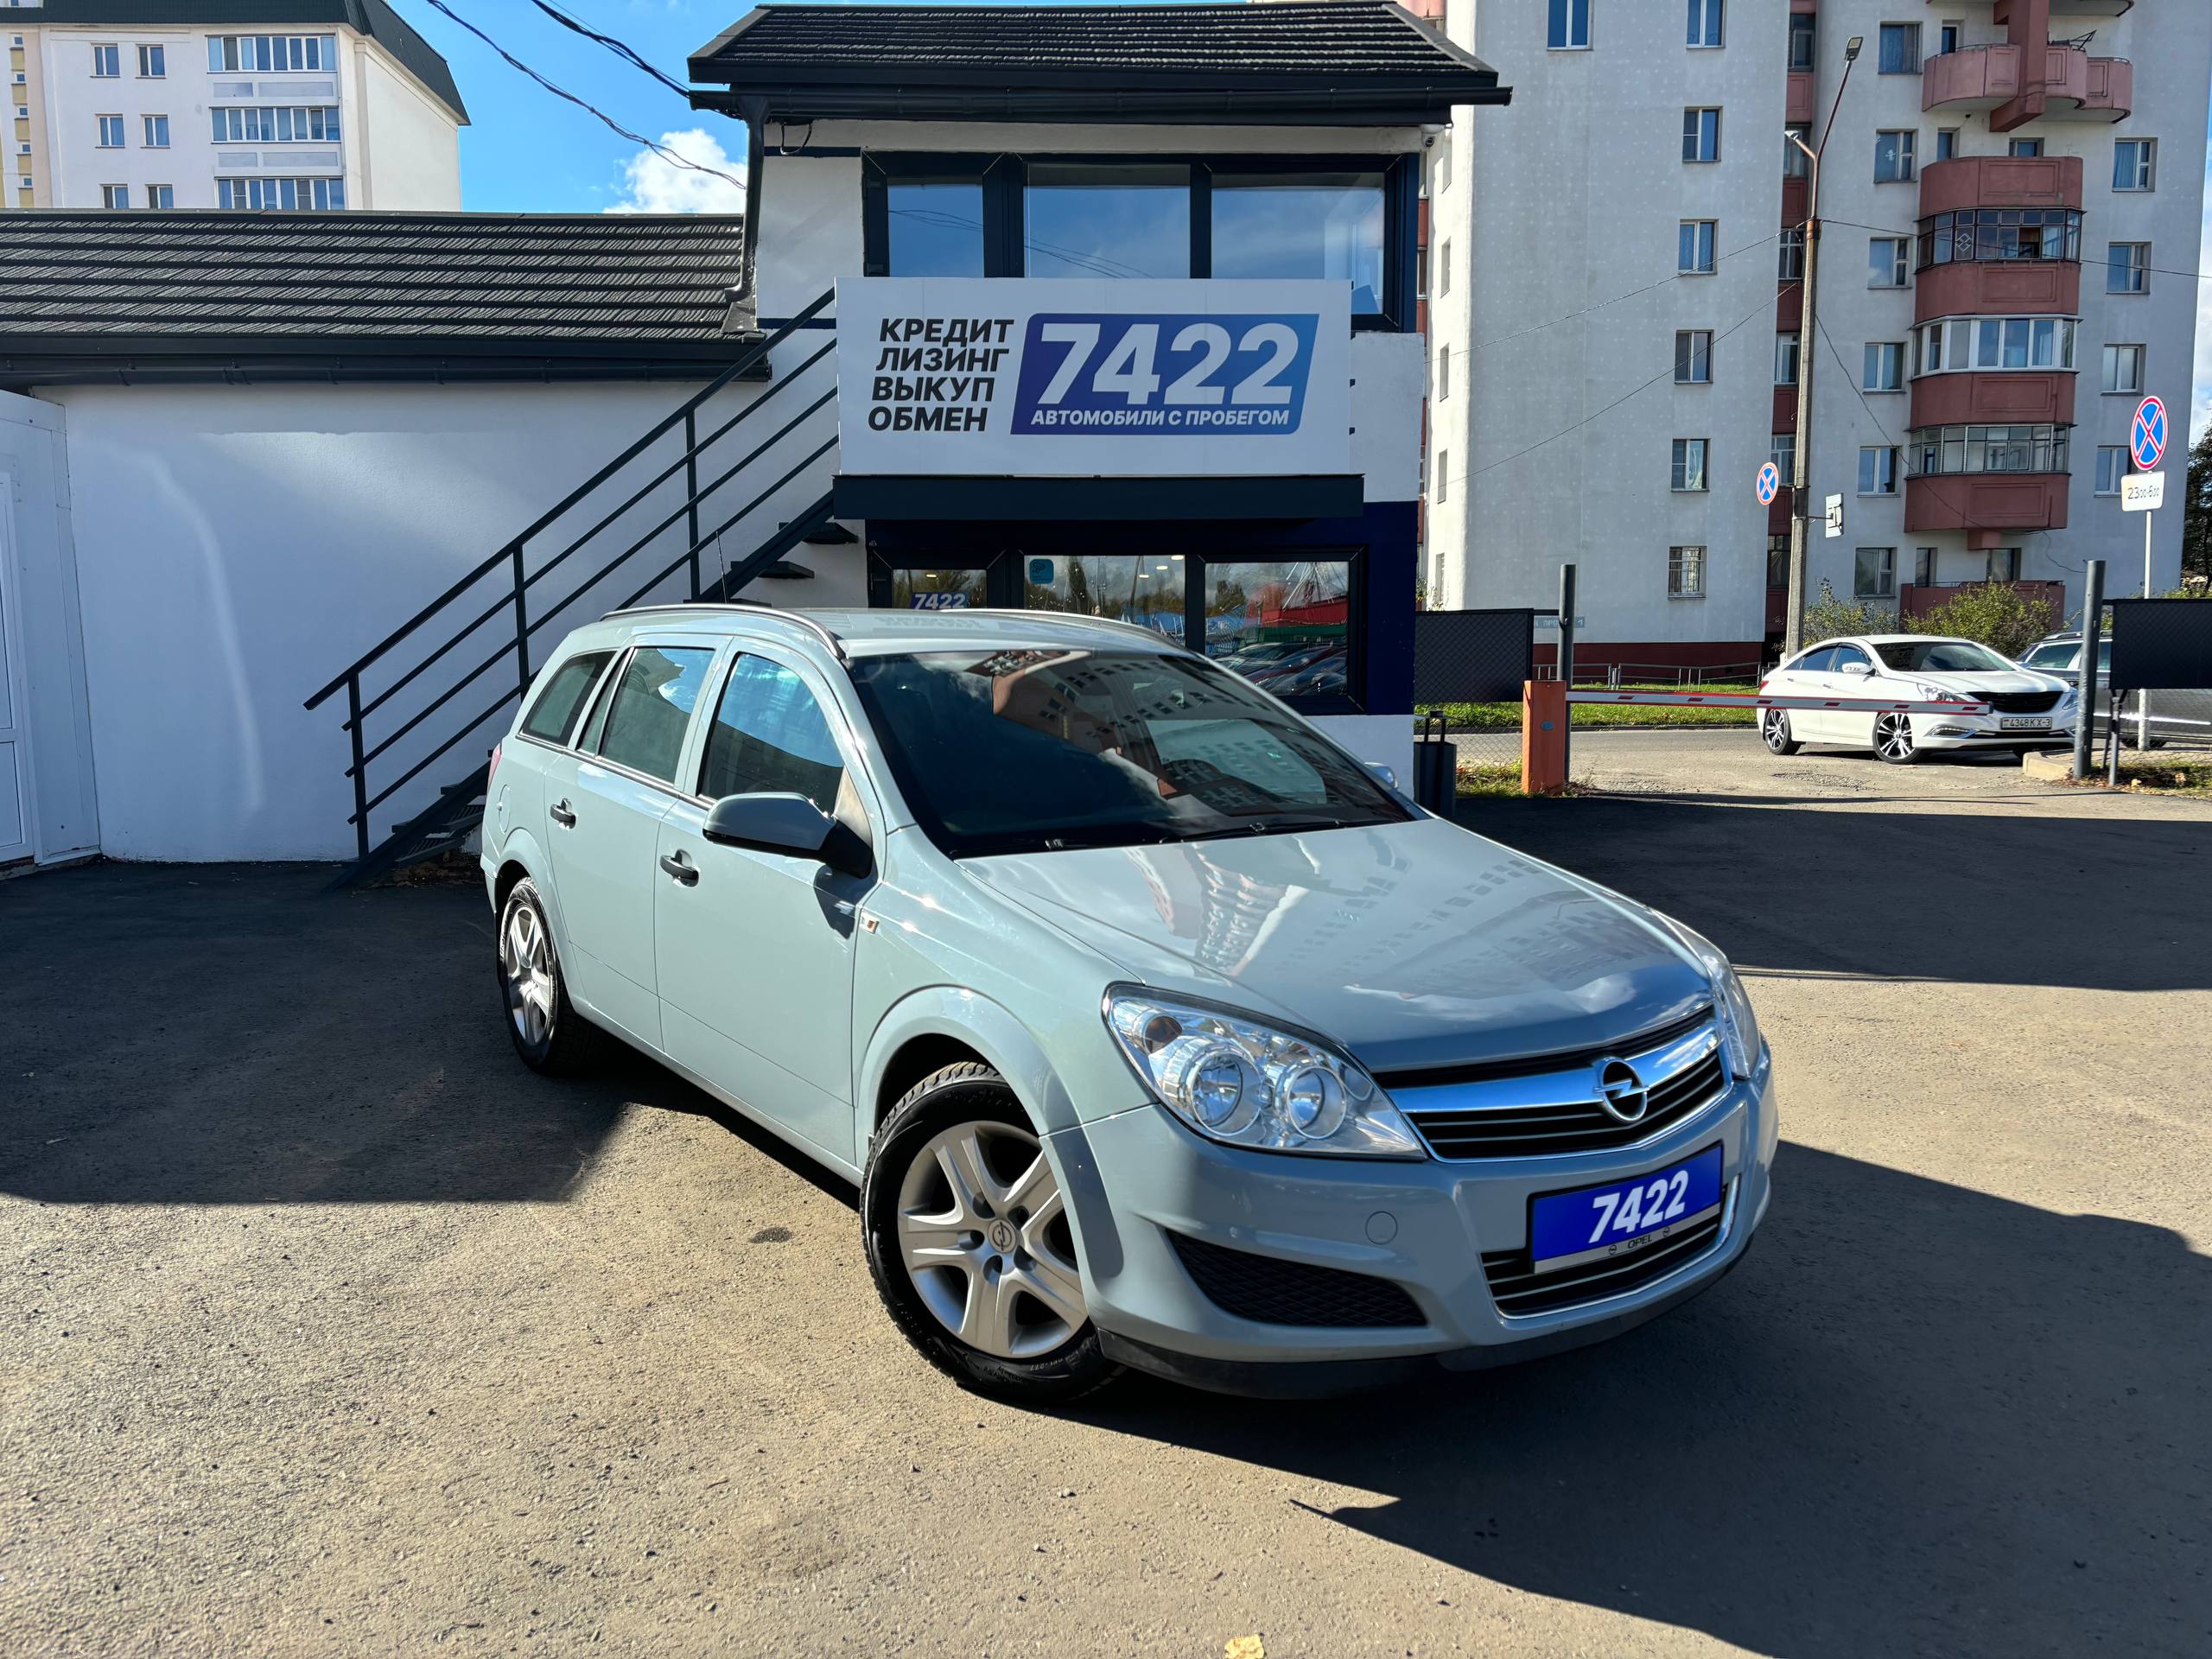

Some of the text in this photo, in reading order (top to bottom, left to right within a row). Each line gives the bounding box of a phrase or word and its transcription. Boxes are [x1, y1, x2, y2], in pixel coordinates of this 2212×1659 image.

[879, 318, 1014, 347] КРЕДИТ
[875, 347, 1009, 372] ЛИЗИНГ
[1037, 322, 1299, 405] 7422
[871, 376, 995, 401] ВЫКУП
[868, 406, 988, 431] ОБМЕН
[1031, 410, 1290, 425] АВТОМОБИЛИ С ПРОБЕГОМ
[913, 593, 965, 610] 7422
[1588, 1170, 1688, 1243] 7422
[1627, 1234, 1652, 1249] OPEL
